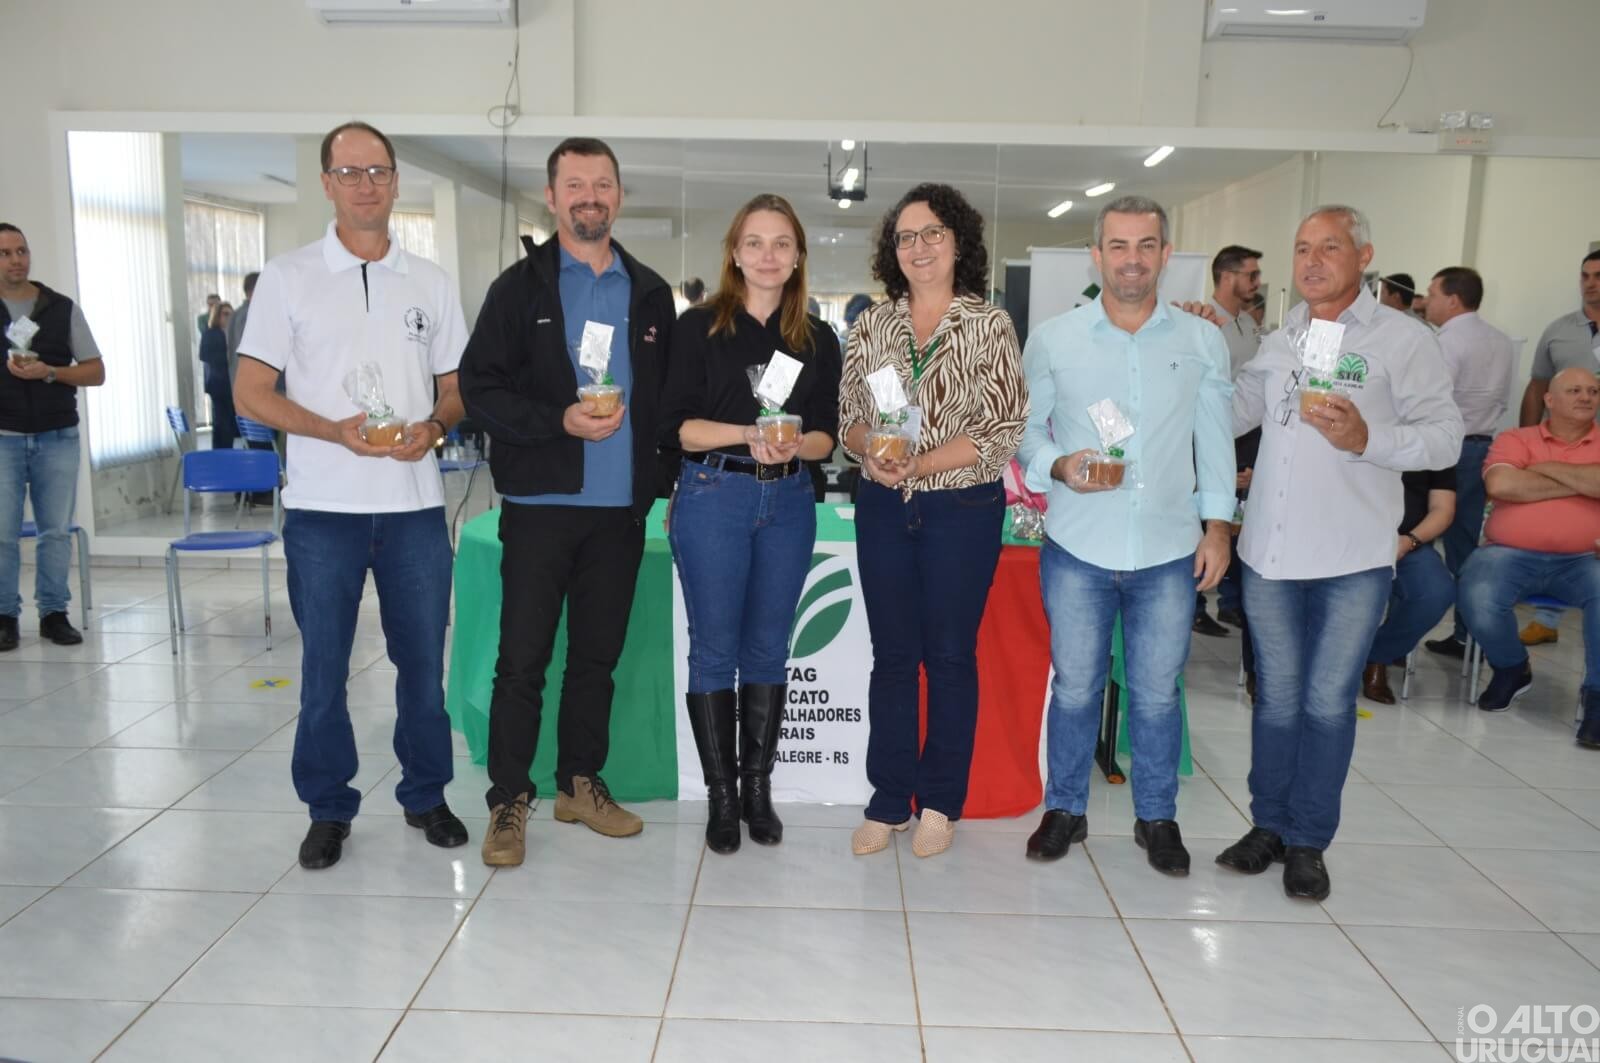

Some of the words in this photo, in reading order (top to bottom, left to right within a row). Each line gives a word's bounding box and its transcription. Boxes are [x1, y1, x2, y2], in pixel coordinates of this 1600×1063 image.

[785, 667, 817, 682] TAG
[783, 708, 862, 722] ALHADORES
[780, 727, 815, 740] RAIS
[774, 751, 822, 764] ALEGRE
[834, 751, 849, 764] RS
